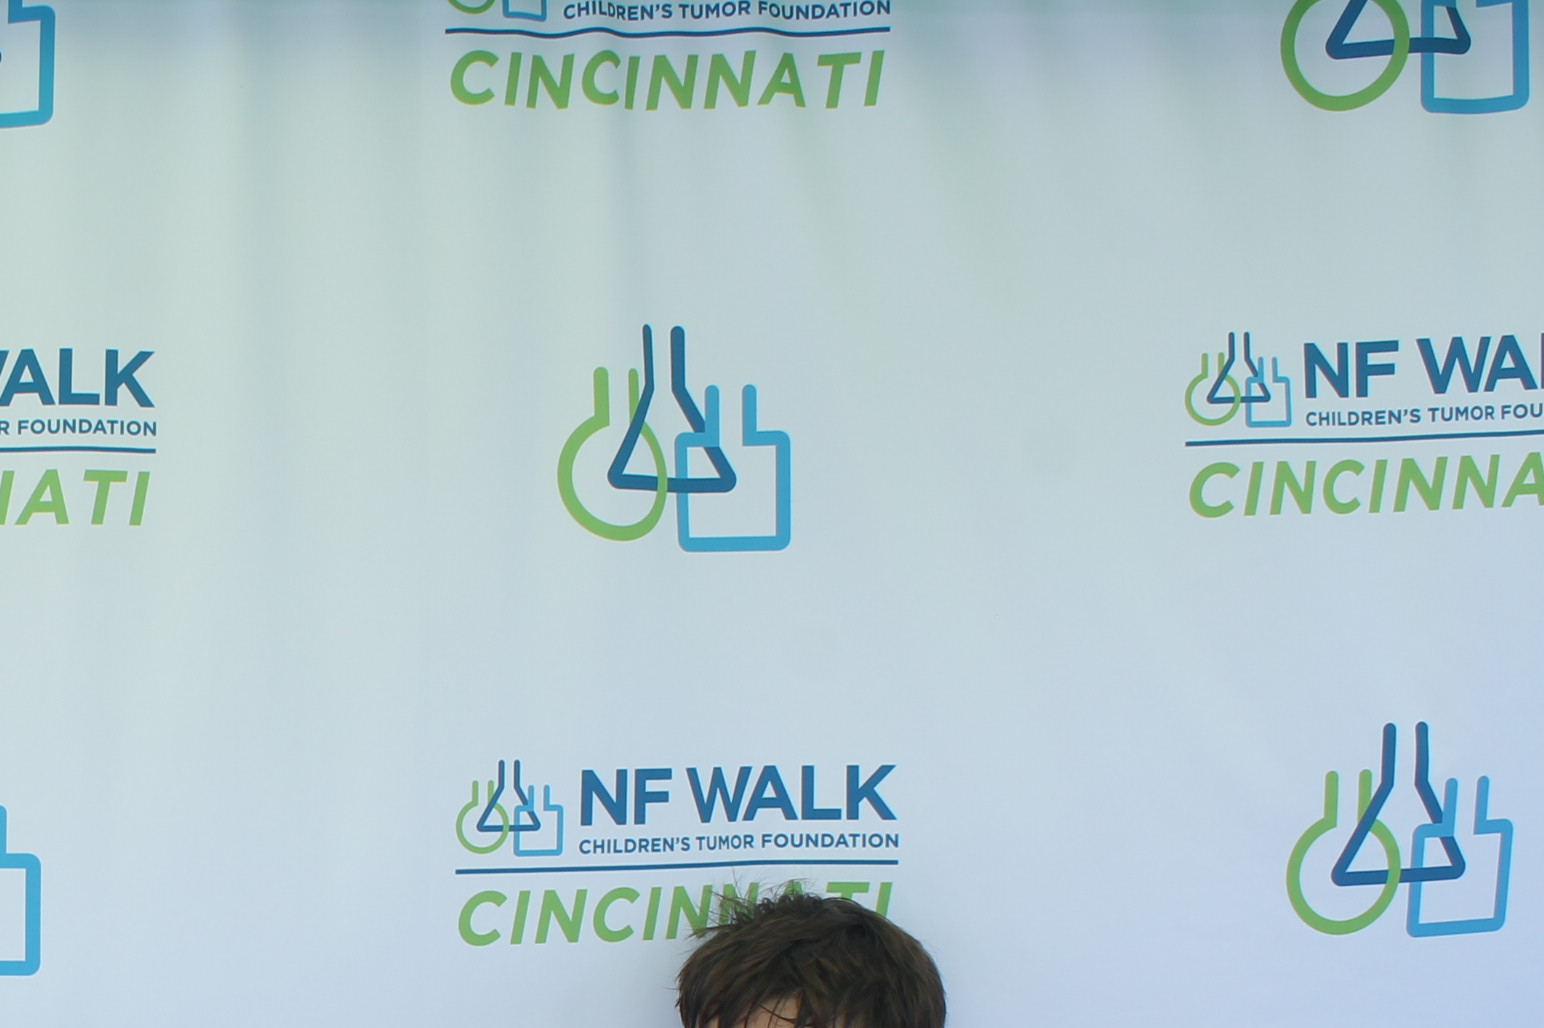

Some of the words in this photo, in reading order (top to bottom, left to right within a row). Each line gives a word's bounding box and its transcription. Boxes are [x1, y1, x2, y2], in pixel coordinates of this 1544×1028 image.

[563, 0, 673, 20] CHILDREN'S
[678, 1, 751, 19] TUMOR
[758, 0, 891, 20] FOUNDATION
[450, 49, 885, 111] CINCINNATI
[1304, 340, 1399, 399] NF
[1306, 409, 1421, 427] CHILDREN'S
[1427, 406, 1495, 422] TUMOR
[17, 419, 157, 438] FOUNDATION
[580, 768, 673, 826] NF
[686, 764, 897, 823] WALK
[578, 835, 690, 855] CHILDREN'S
[695, 834, 754, 851] TUMOR
[760, 832, 900, 849] FOUNDATION
